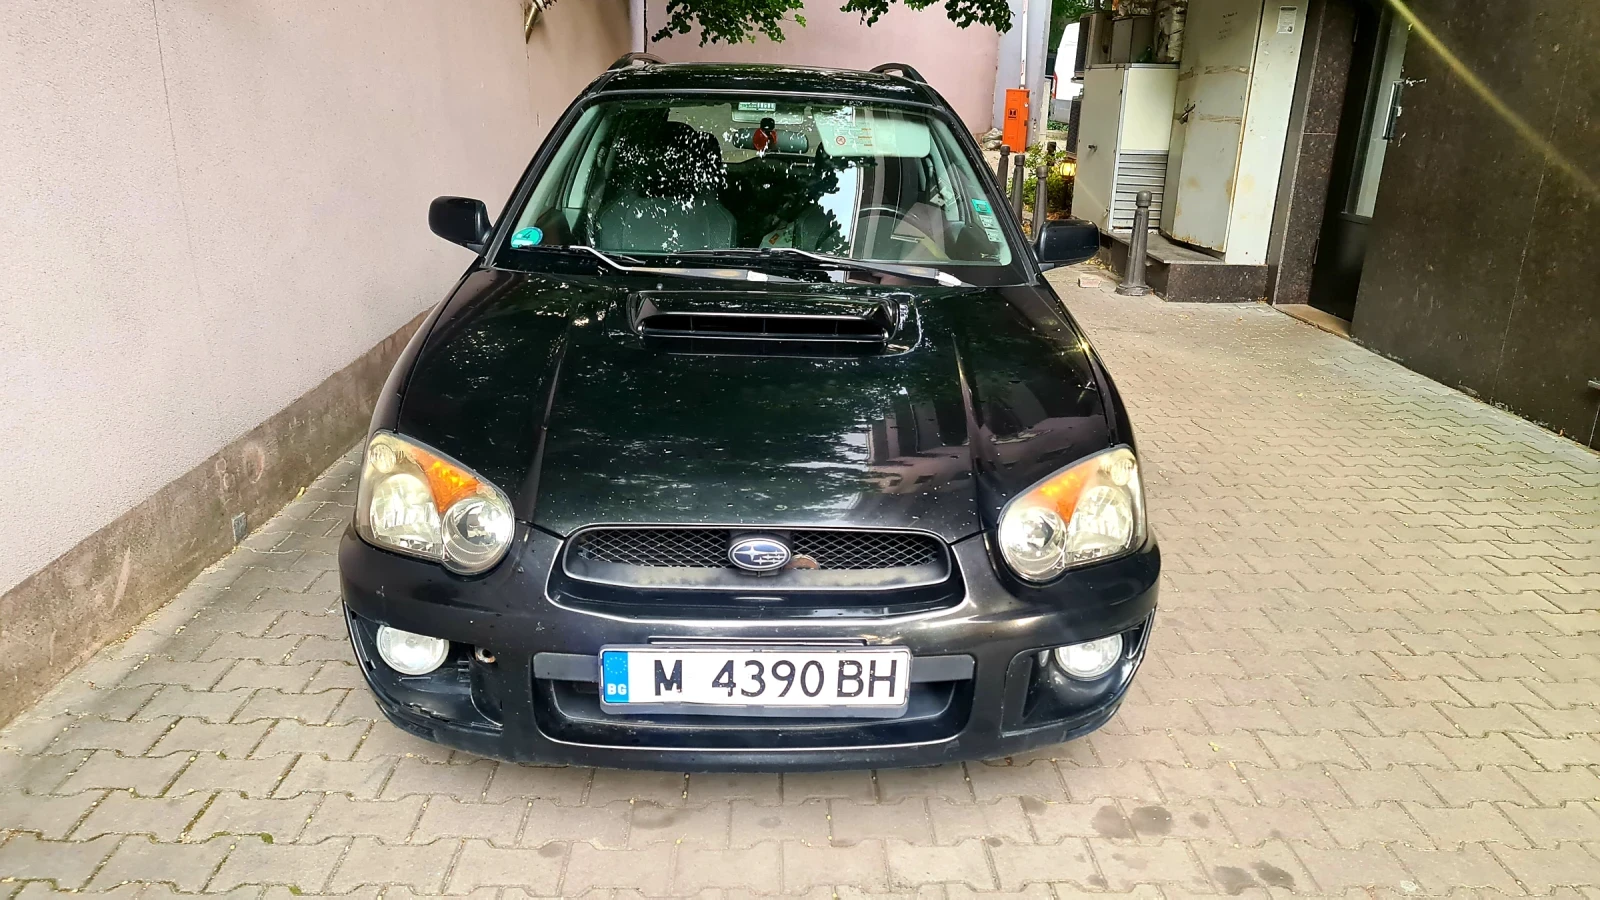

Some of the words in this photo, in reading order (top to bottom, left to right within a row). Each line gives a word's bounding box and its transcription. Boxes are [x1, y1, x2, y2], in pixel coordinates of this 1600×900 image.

[607, 683, 627, 696] BG
[654, 659, 683, 696] M
[711, 659, 825, 698] 4390
[836, 659, 897, 698] BH
